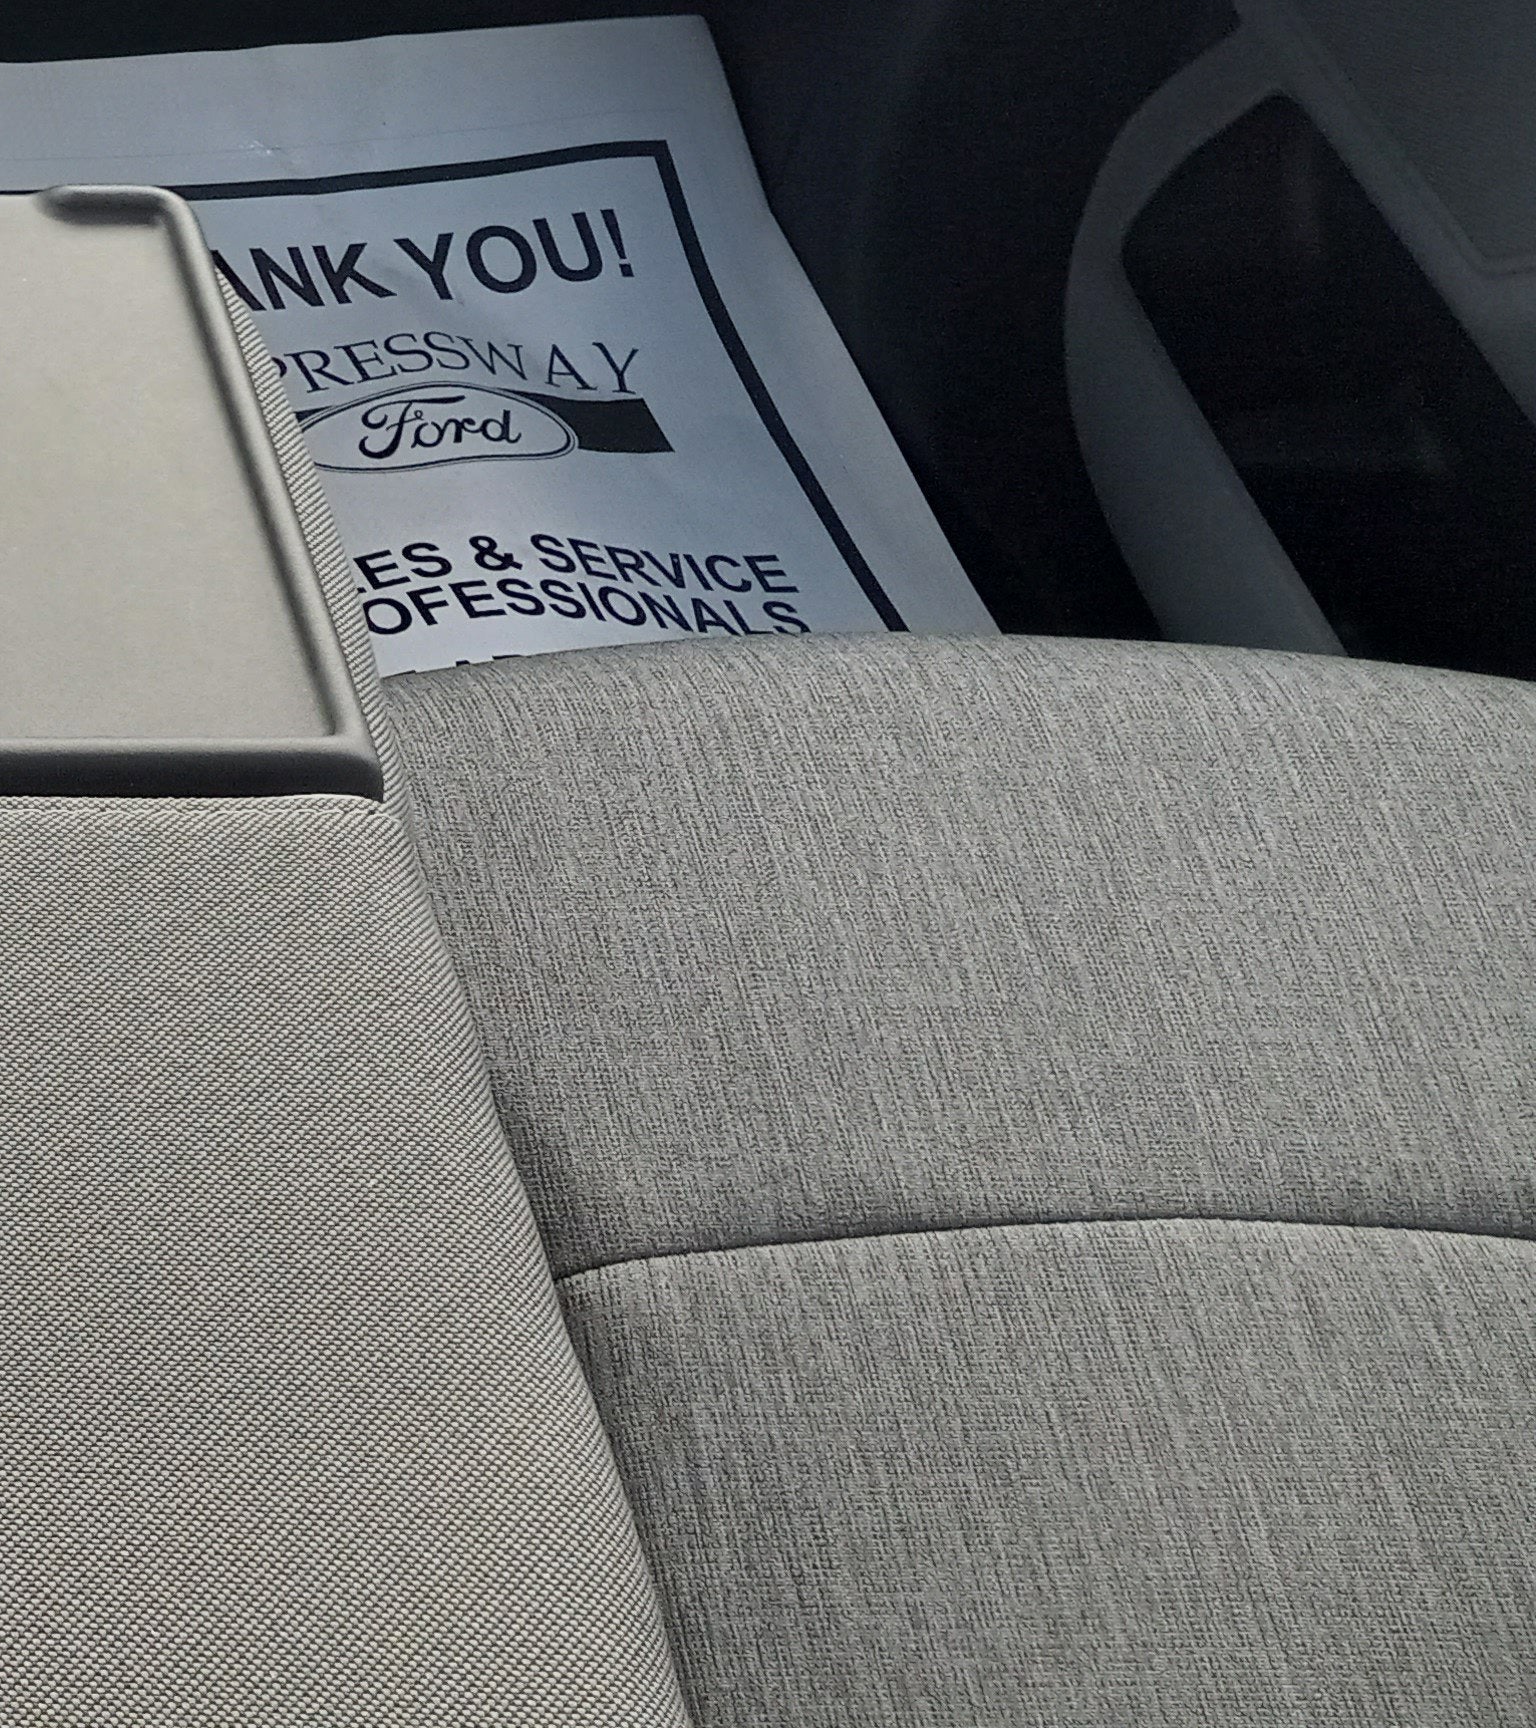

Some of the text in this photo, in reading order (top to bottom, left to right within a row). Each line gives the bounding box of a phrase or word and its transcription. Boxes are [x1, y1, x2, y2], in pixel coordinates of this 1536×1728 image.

[394, 208, 635, 300] YOU!
[358, 394, 522, 459] Ford
[469, 535, 523, 572] &
[530, 533, 800, 594] SERVICE
